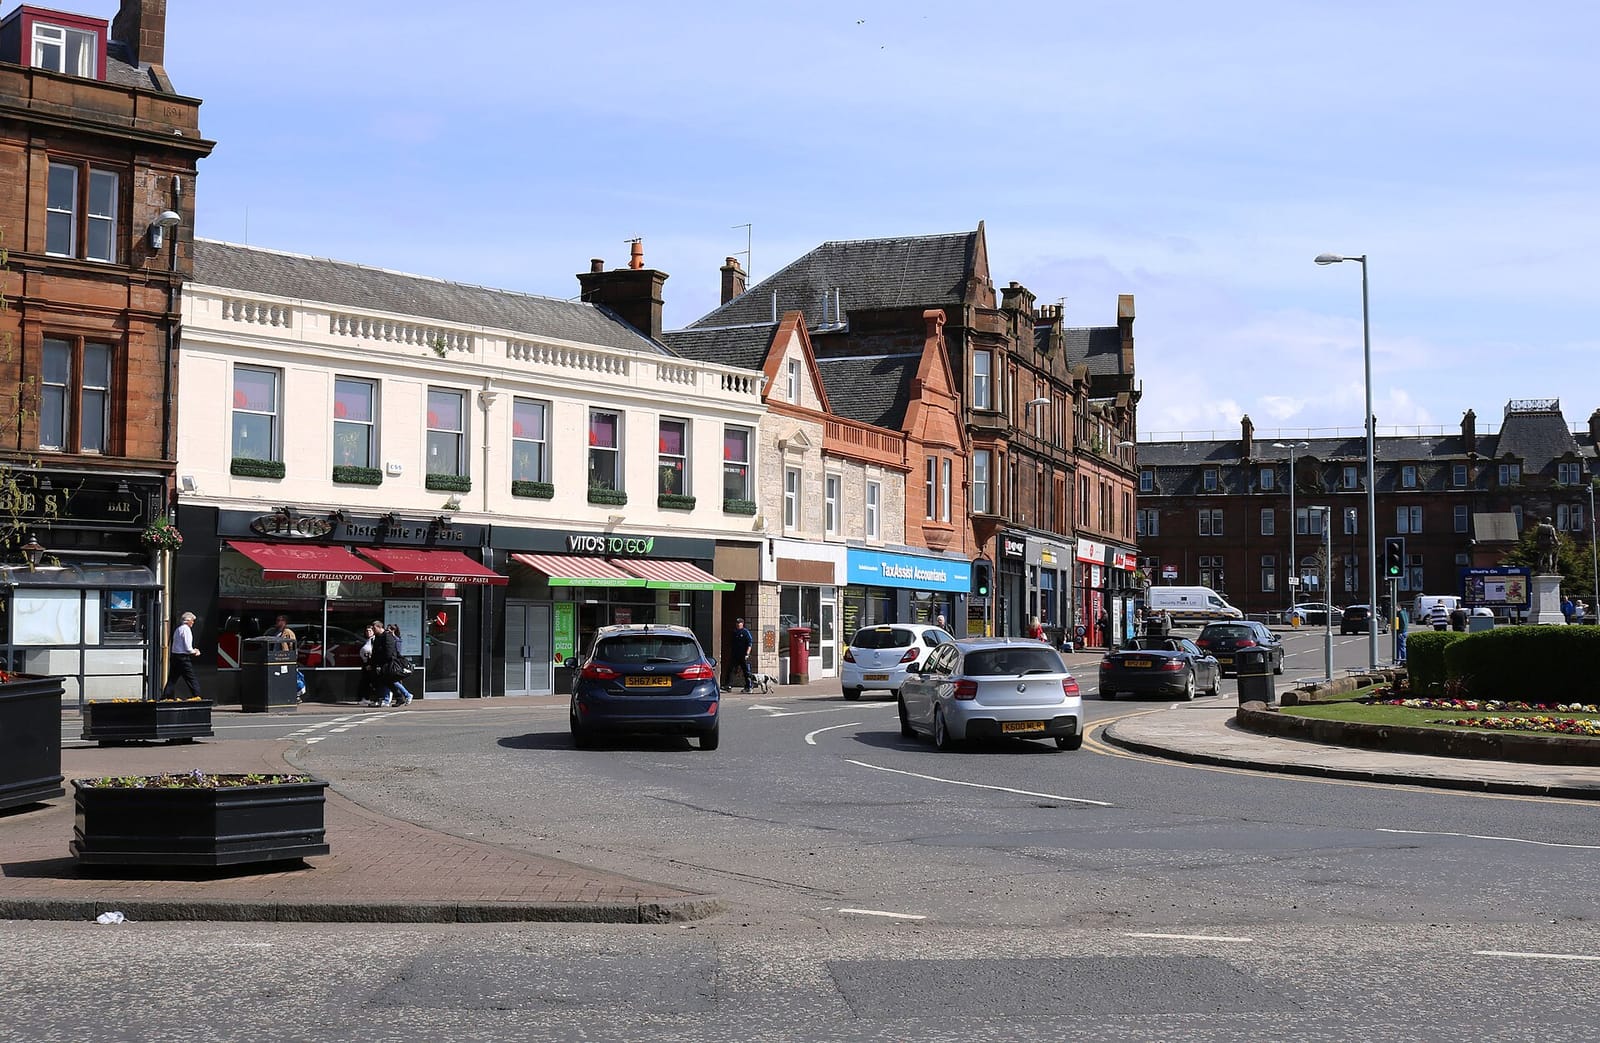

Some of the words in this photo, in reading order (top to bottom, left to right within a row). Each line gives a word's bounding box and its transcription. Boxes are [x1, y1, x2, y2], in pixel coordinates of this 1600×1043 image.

[163, 106, 182, 119] 1894
[107, 502, 130, 512] BAR
[346, 525, 410, 538] Ristoante
[415, 528, 463, 540] Pizeria
[569, 535, 605, 551] VITO'S
[608, 537, 623, 552] TO
[626, 538, 647, 553] GO
[881, 562, 913, 580] TaxAssist
[913, 566, 947, 582] Accountants
[628, 677, 650, 685] SH67
